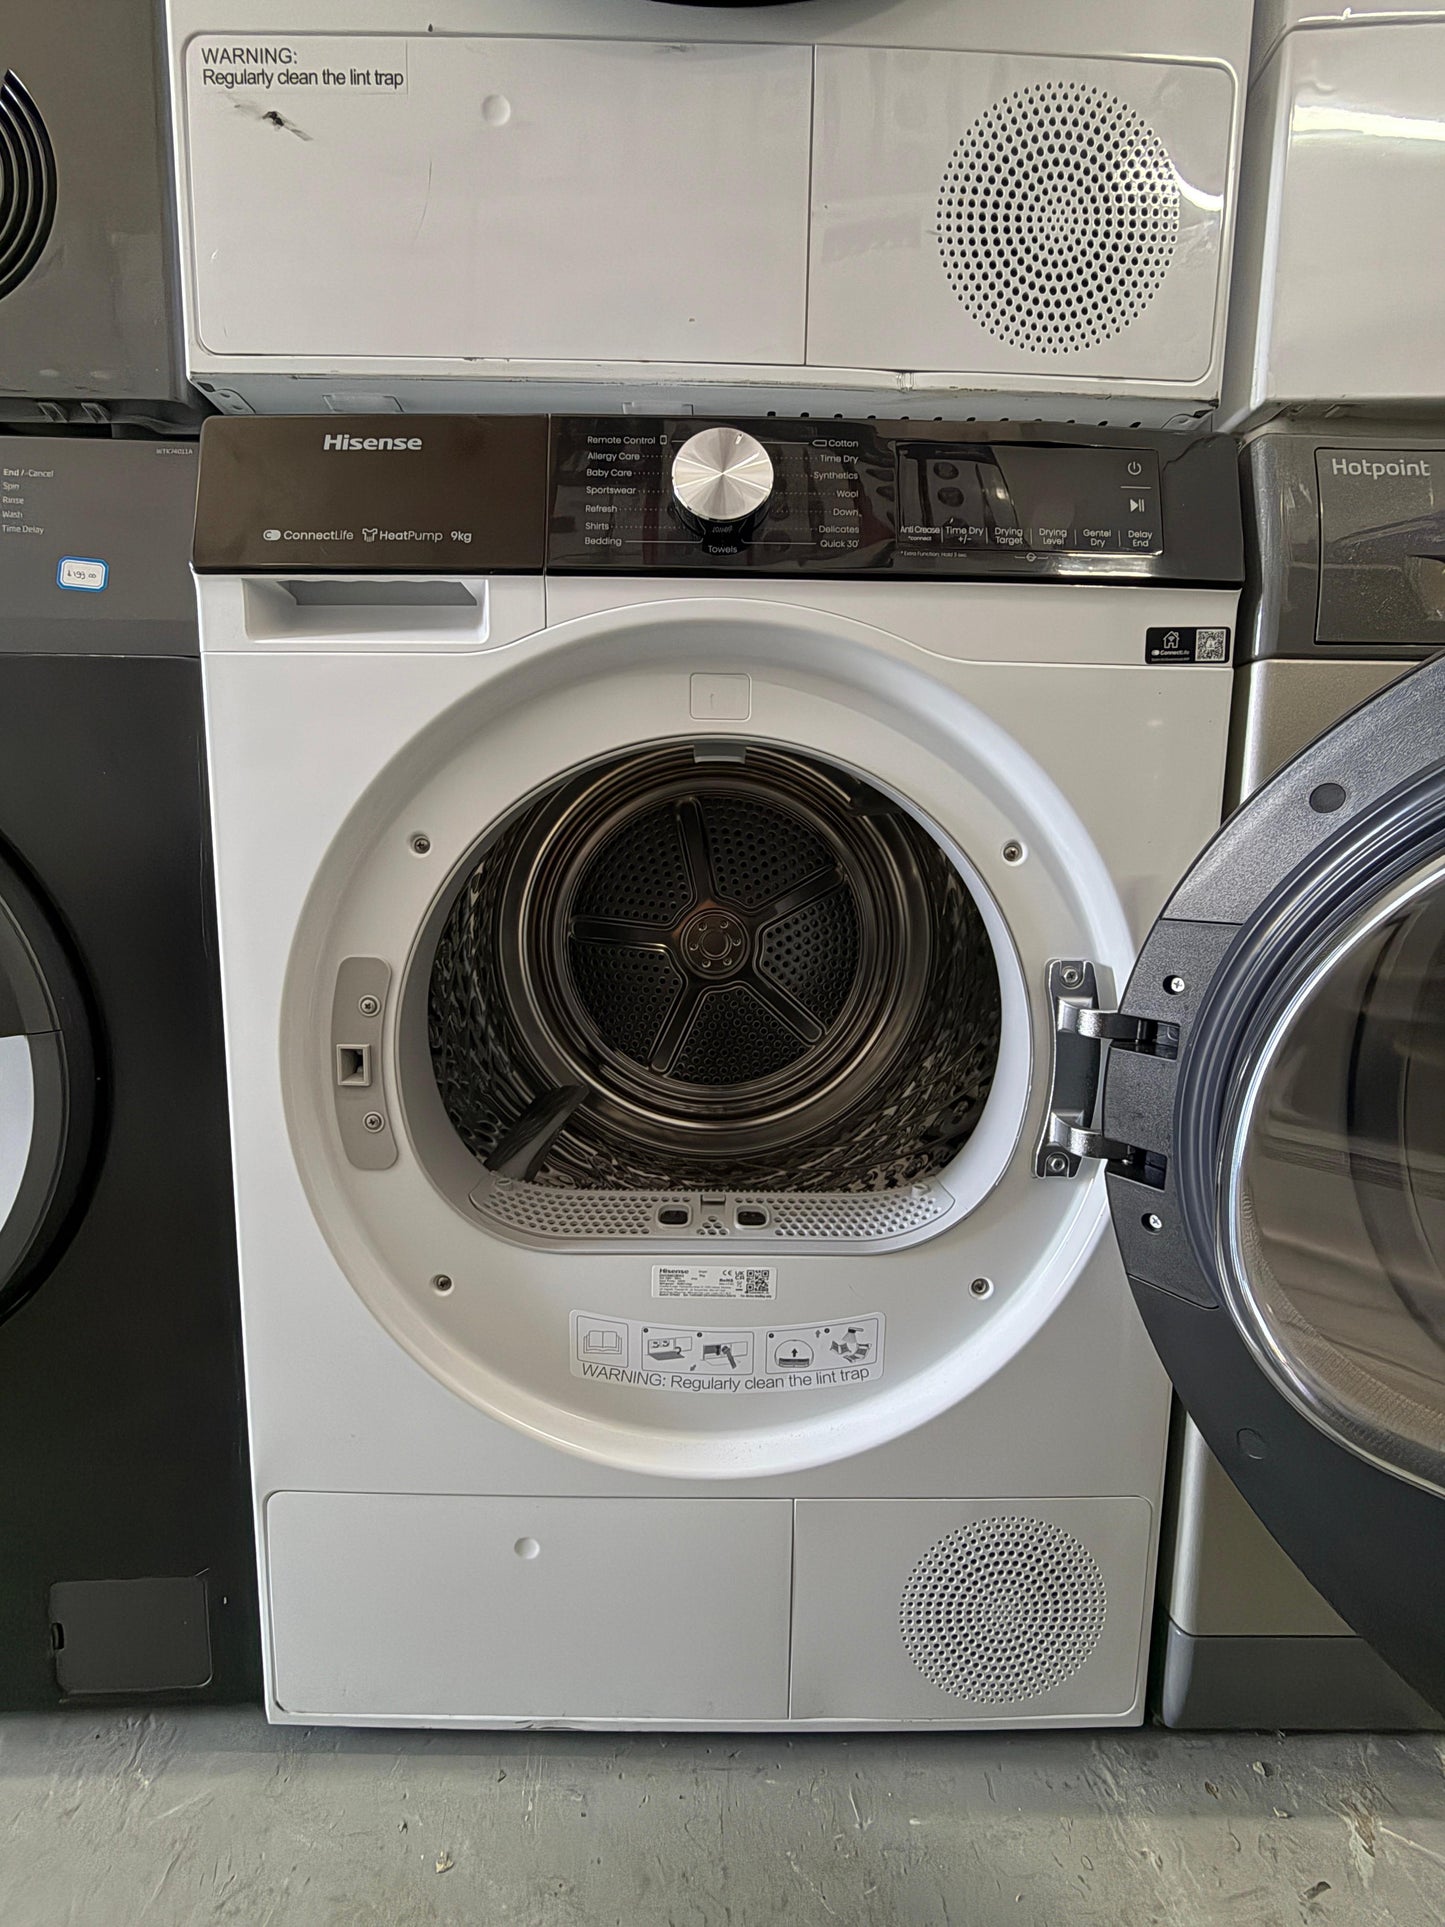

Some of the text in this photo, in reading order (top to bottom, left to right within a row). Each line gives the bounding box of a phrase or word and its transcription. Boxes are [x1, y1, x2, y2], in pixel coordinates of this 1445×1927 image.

[201, 47, 298, 64] WARNING:
[203, 68, 404, 90] Regularly clean the lint trap
[323, 434, 423, 450] Hisense
[587, 435, 656, 445] Remote Control
[828, 439, 859, 448] Cotton
[587, 452, 640, 462] Allergy Care
[820, 455, 859, 465] Time Dry
[3, 468, 20, 477] End
[28, 470, 54, 478] Cancel
[586, 468, 633, 478] Baby Care
[1332, 458, 1431, 480] Hotpoint
[814, 471, 859, 481] Synthetics
[2, 482, 20, 491] Spin
[586, 485, 637, 495] Sportswear
[836, 490, 859, 498] Wool
[2, 496, 25, 504] Rinse
[585, 504, 618, 513] Refresh
[832, 508, 859, 516] Down
[2, 510, 23, 519] Wash
[2, 524, 45, 535] Time Delay
[585, 522, 609, 530] Shirts
[818, 525, 860, 534] Delicates
[914, 526, 941, 534] Crease
[283, 529, 473, 544] ConnectLife HeatPump 9kg
[945, 526, 984, 537] Time Dry
[994, 527, 1023, 537] Drying
[1039, 528, 1068, 538] Drying
[1127, 530, 1153, 539] Delay
[584, 536, 622, 547] Bedding
[820, 539, 845, 548] Quick
[995, 536, 1023, 546] Target
[1043, 537, 1065, 545] Level
[1090, 538, 1106, 548] Dry
[708, 545, 738, 553] Towels
[582, 1362, 870, 1392] WARNING: Regularly clean the lint trap
